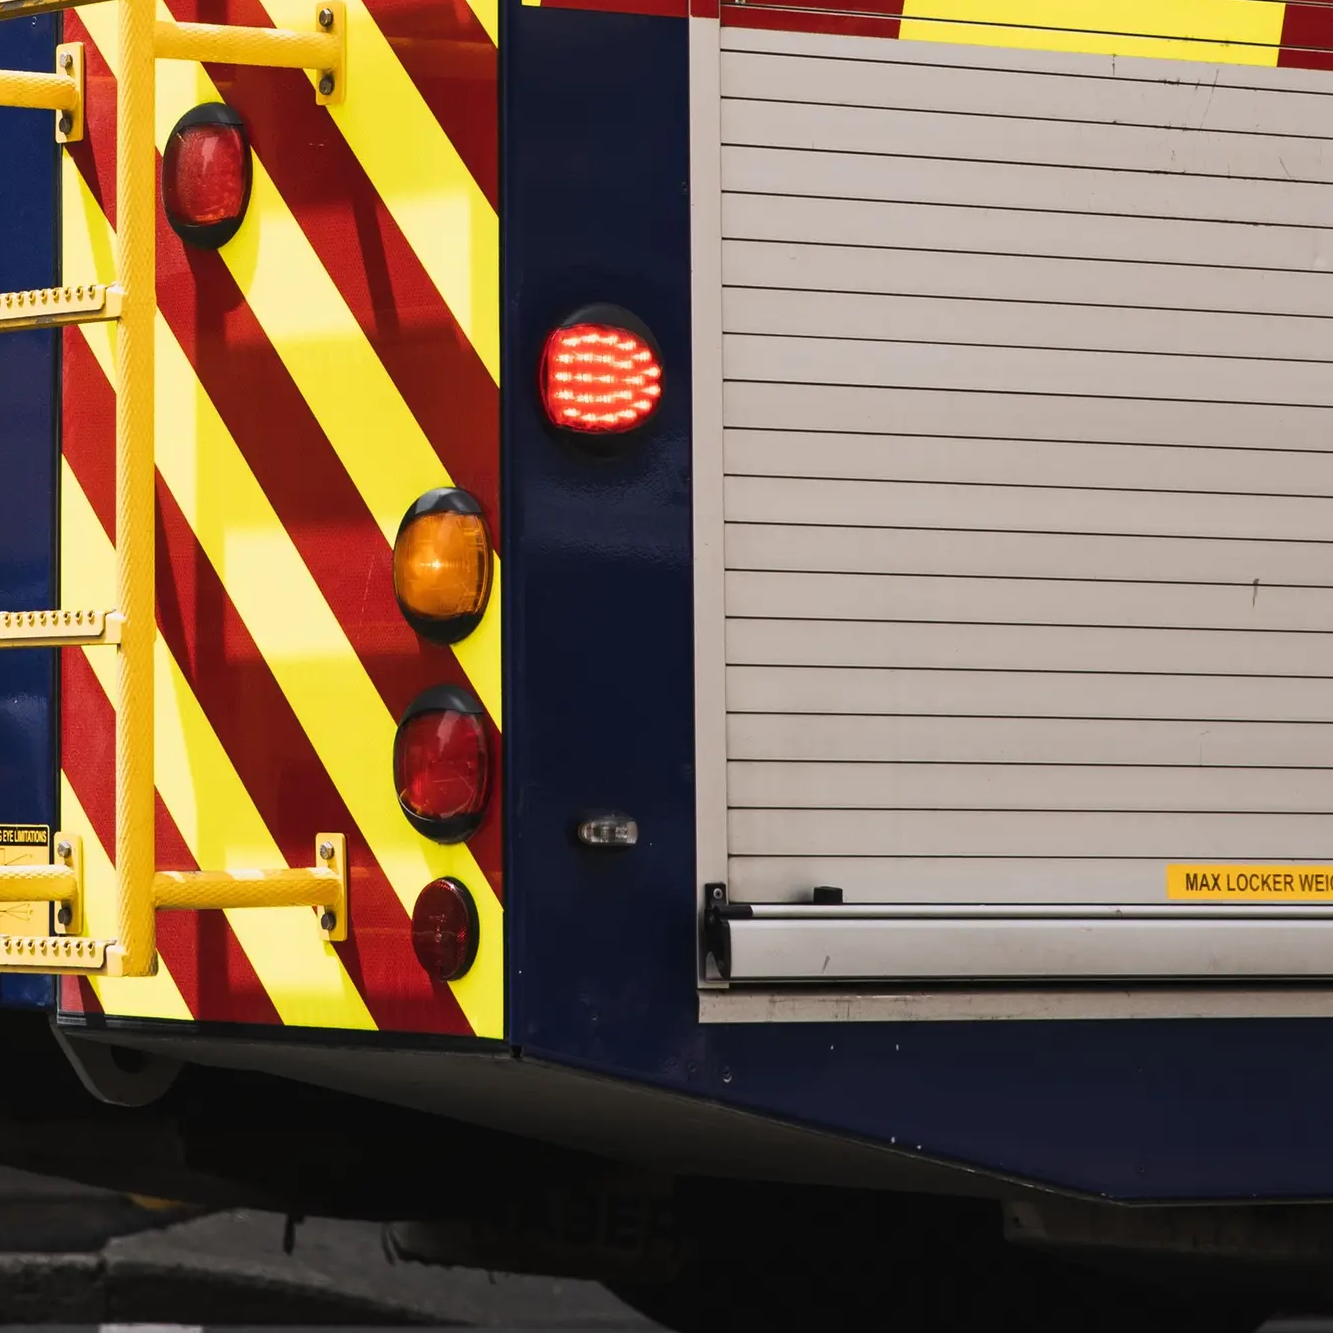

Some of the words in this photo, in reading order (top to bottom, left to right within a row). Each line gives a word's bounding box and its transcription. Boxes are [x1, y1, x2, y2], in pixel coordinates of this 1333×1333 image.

[3, 829, 14, 843] EYE
[1185, 873, 1222, 892] MAX
[1226, 873, 1295, 892] LOCKER
[1298, 873, 1333, 892] WEI
